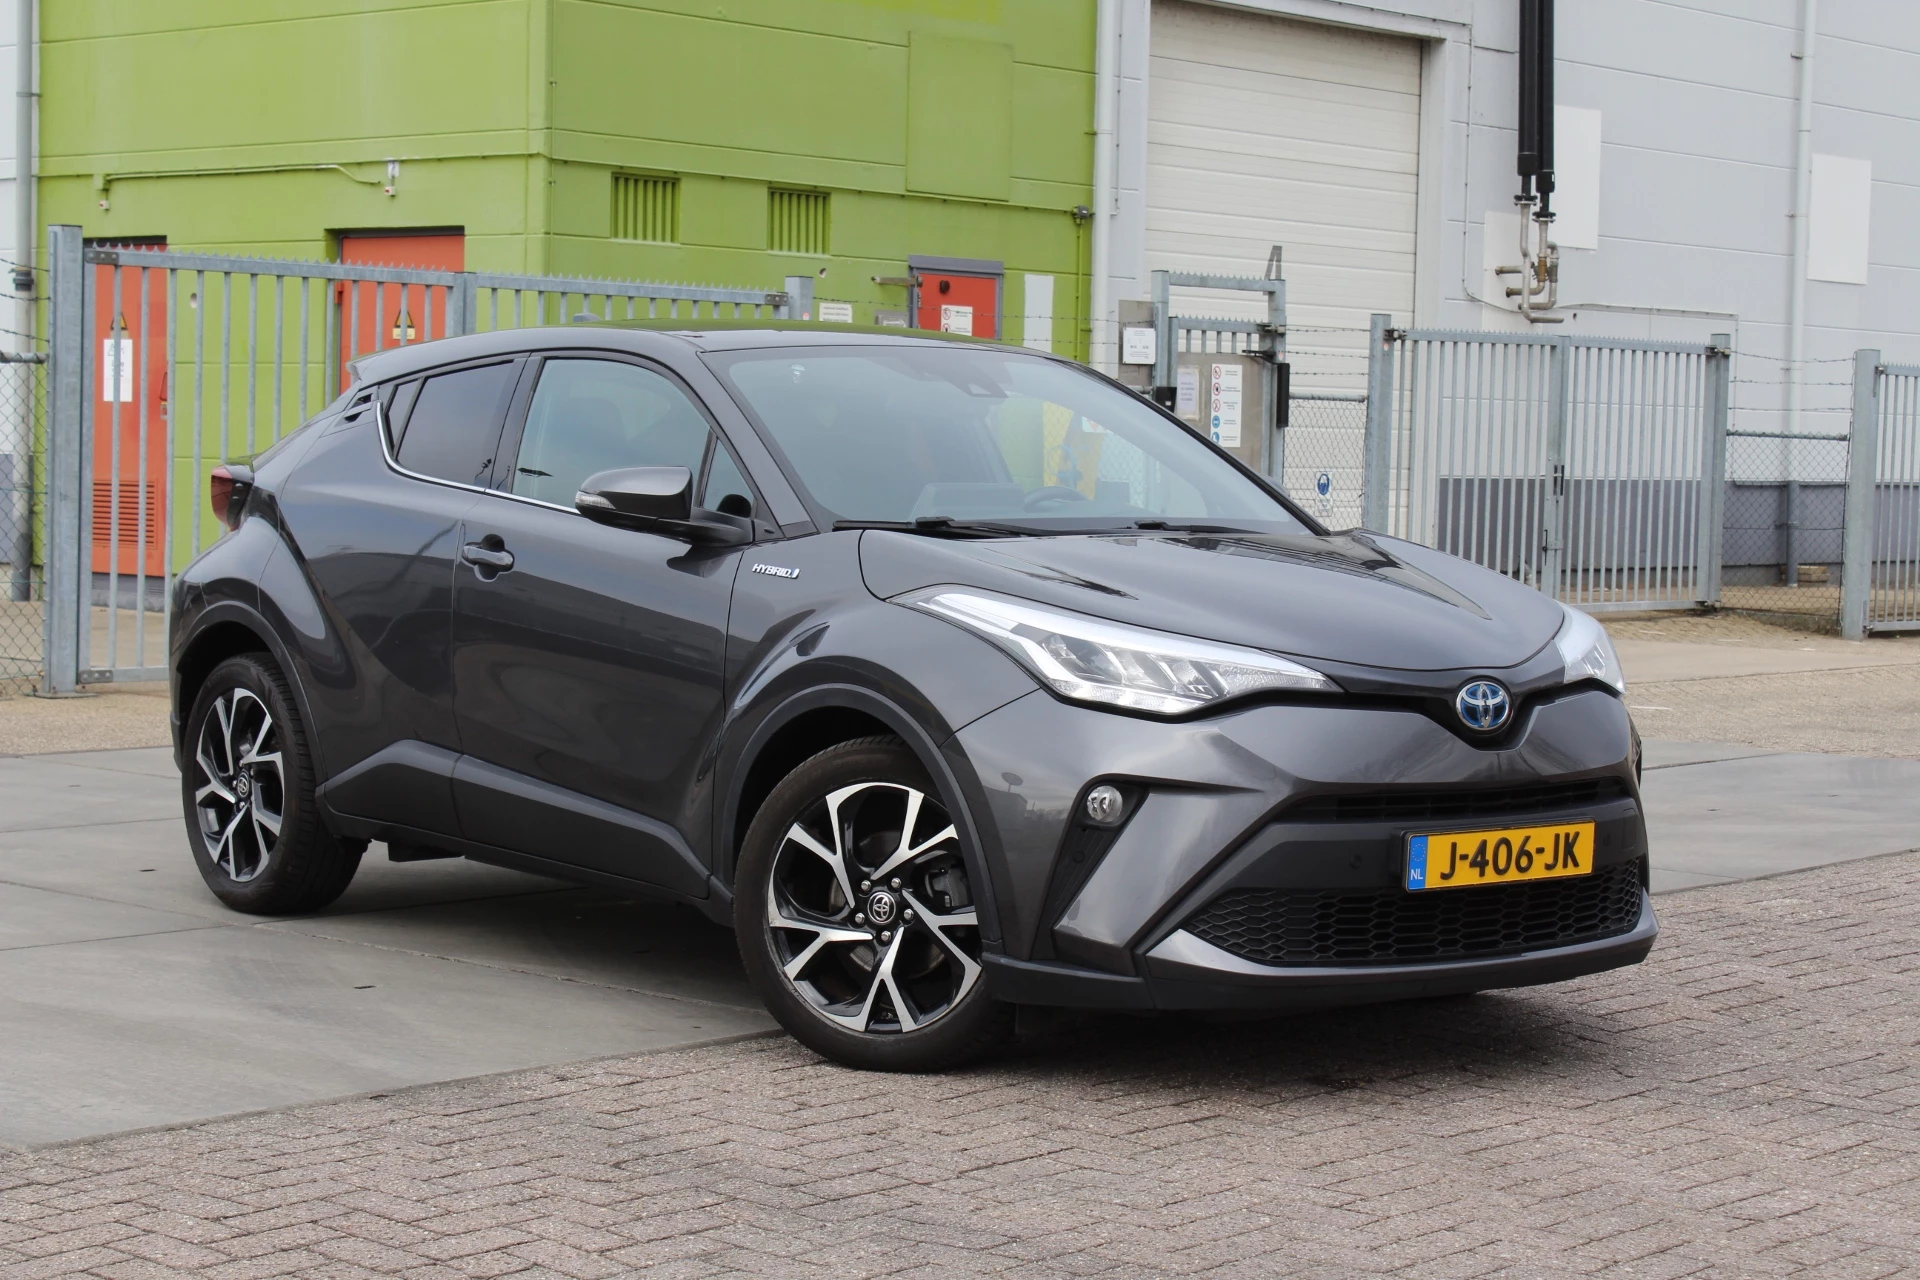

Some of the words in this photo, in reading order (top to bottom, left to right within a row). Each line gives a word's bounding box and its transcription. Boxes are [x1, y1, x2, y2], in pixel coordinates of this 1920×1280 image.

[752, 563, 792, 578] HYBRID
[1440, 831, 1580, 880] J-406-JK
[1410, 868, 1423, 881] NL
